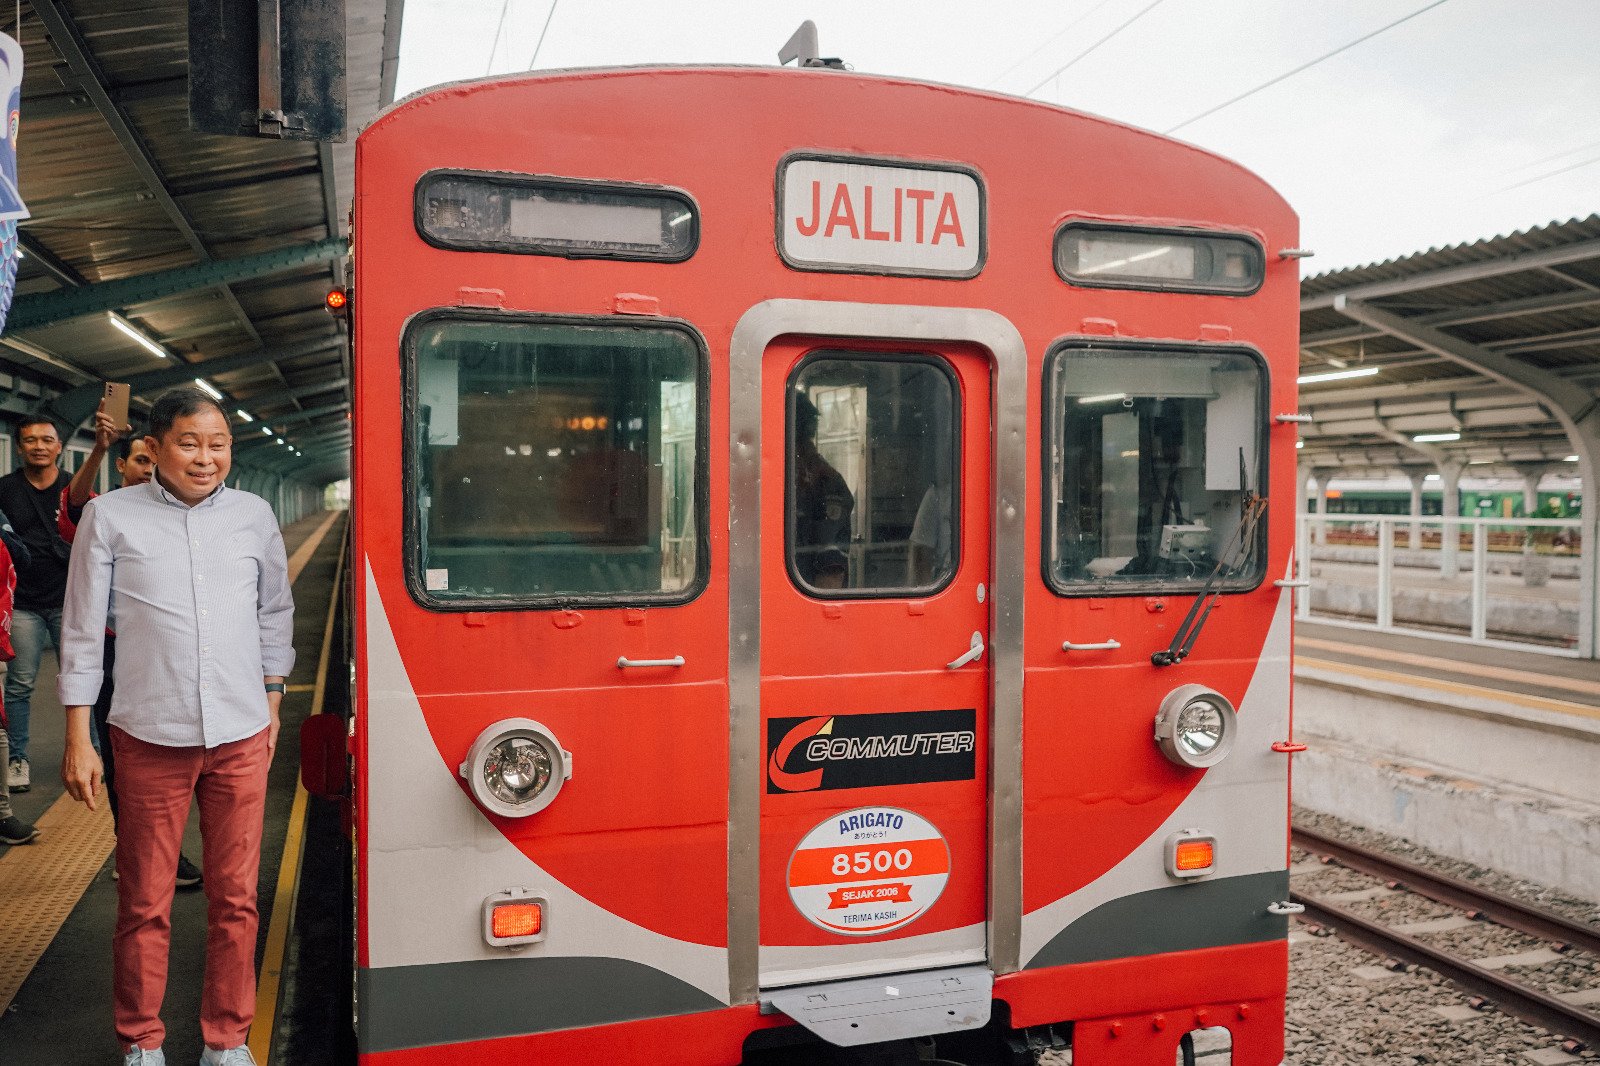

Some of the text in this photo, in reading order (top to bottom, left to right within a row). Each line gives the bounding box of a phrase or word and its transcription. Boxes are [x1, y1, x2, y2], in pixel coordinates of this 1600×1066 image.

[795, 180, 965, 247] JALITA
[806, 732, 975, 761] COMMUTER
[839, 812, 903, 835] ARIGATO
[832, 848, 913, 875] 8500
[842, 887, 898, 901] SEJAK 2006
[843, 911, 897, 924] TERIMA KASIH
